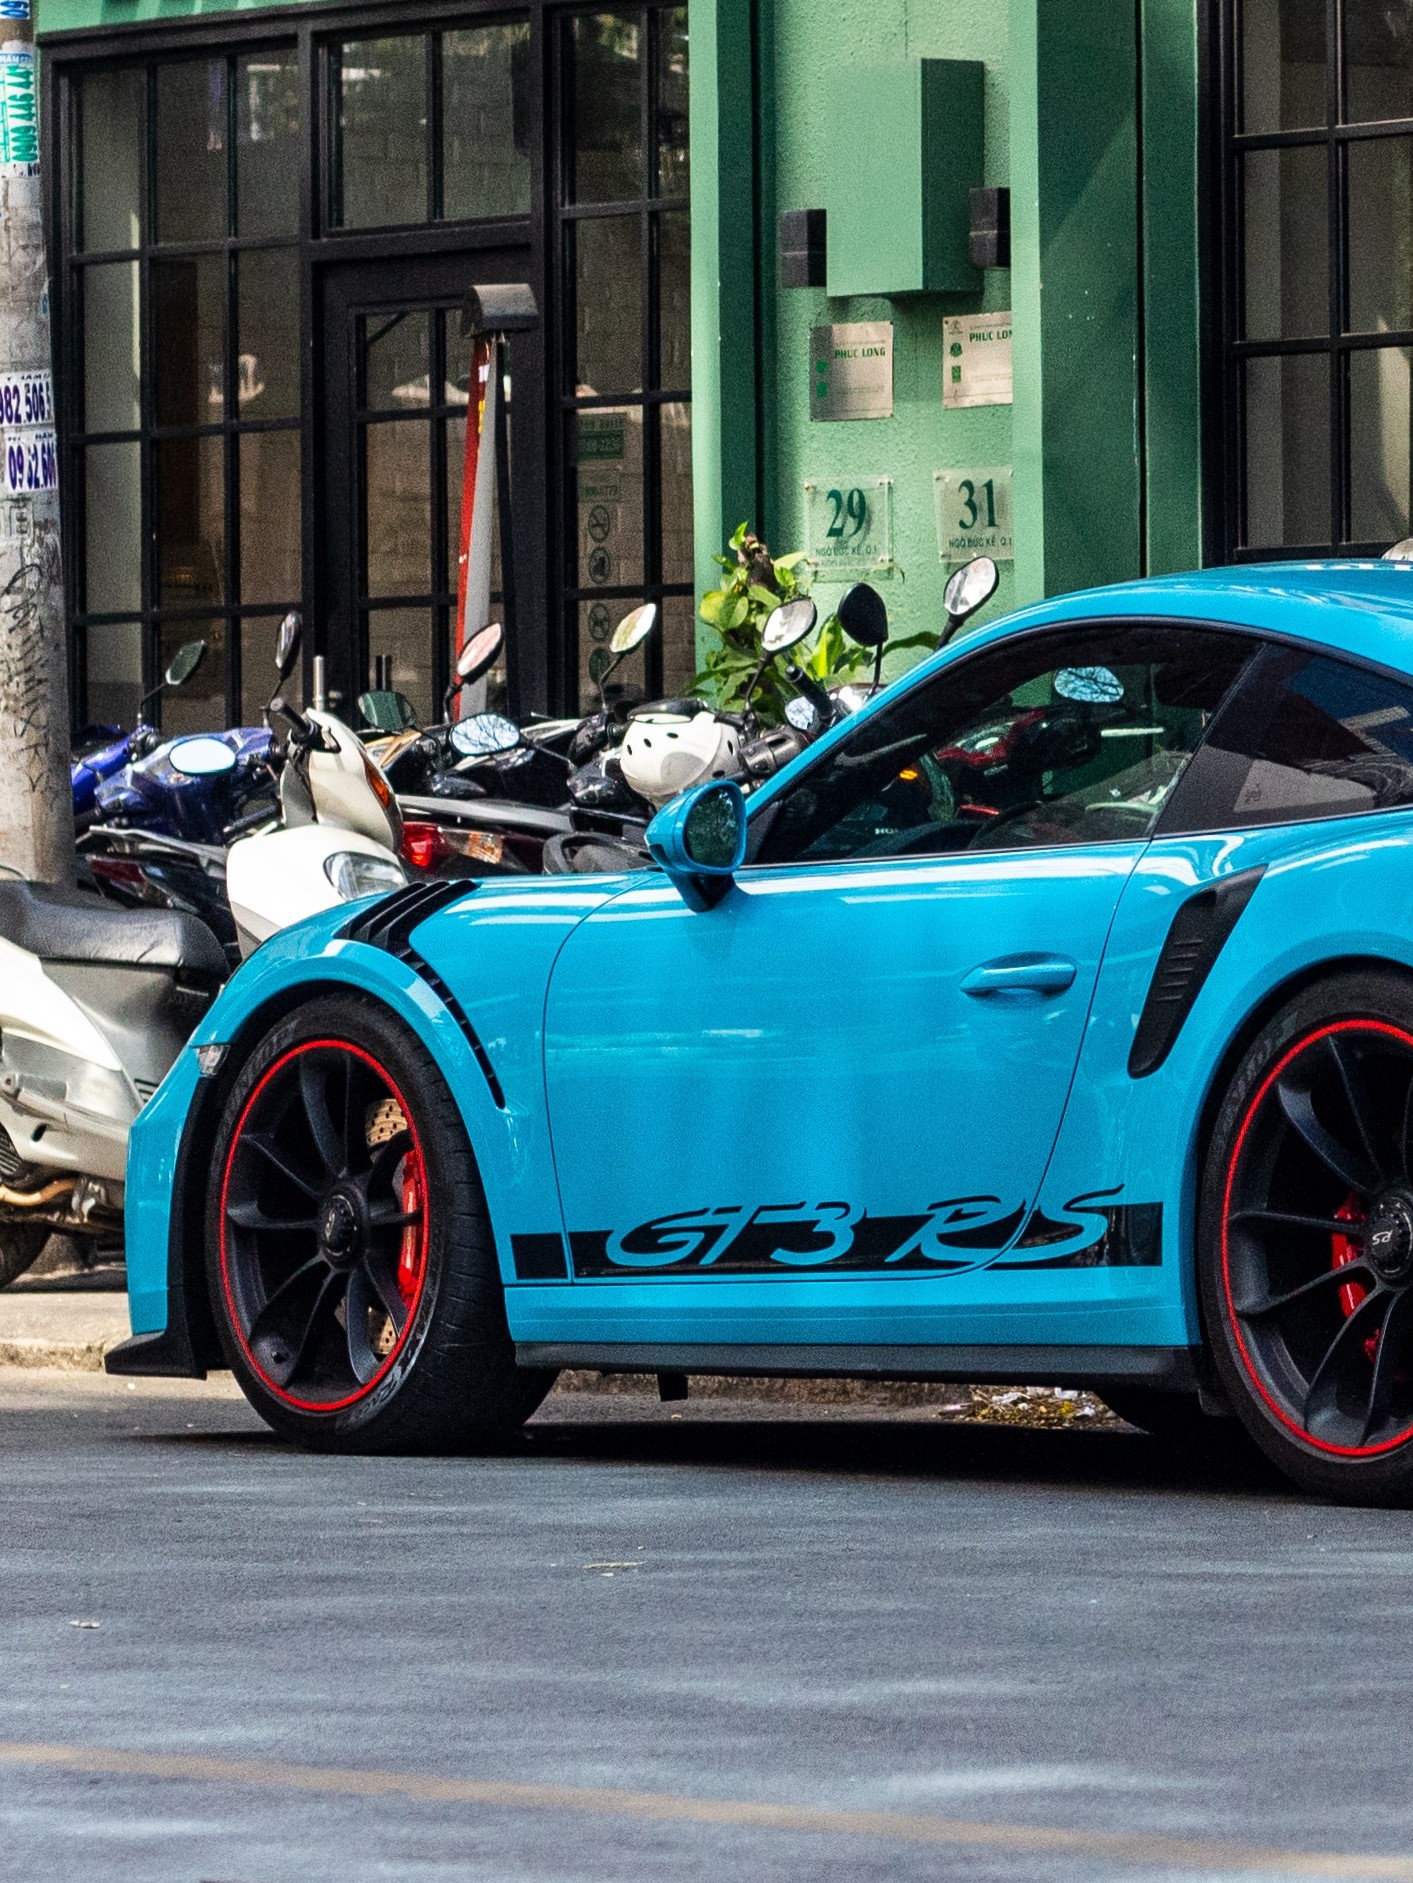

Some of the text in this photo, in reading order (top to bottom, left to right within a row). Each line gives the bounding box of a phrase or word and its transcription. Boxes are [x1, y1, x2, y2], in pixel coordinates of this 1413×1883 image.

[861, 346, 886, 358] LONG
[826, 487, 867, 538] 29
[957, 478, 1000, 529] 31
[604, 1183, 1127, 1267] GT3 RS
